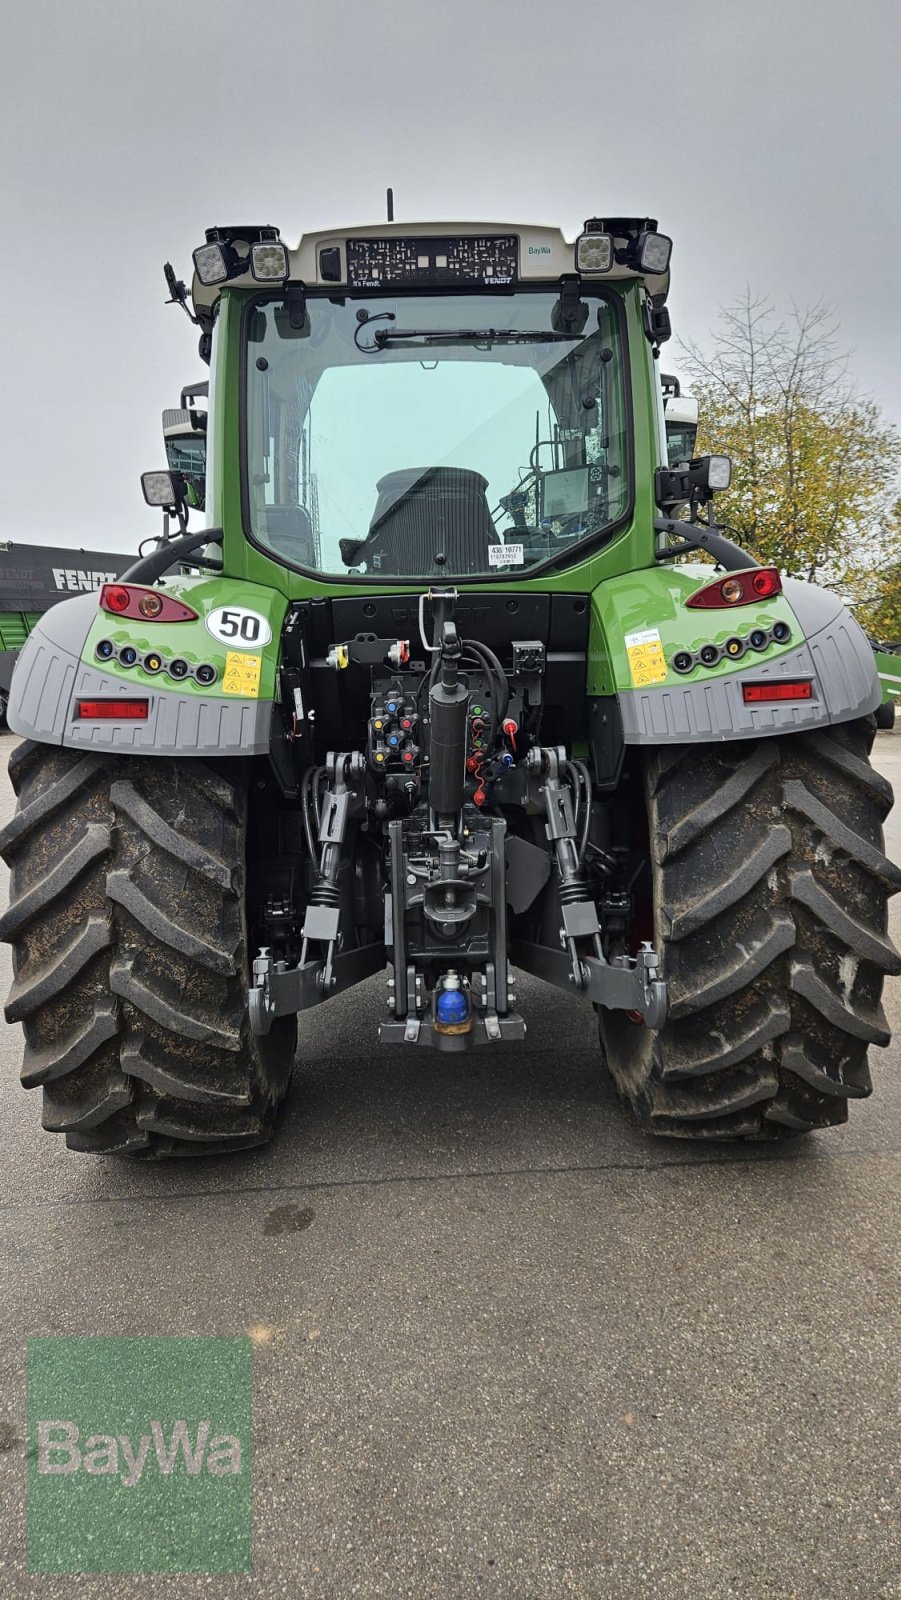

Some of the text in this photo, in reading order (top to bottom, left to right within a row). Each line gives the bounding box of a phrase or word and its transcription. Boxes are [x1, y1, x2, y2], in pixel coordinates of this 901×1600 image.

[528, 246, 551, 255] BayWa
[484, 277, 512, 285] FENDT
[219, 610, 260, 642] 50
